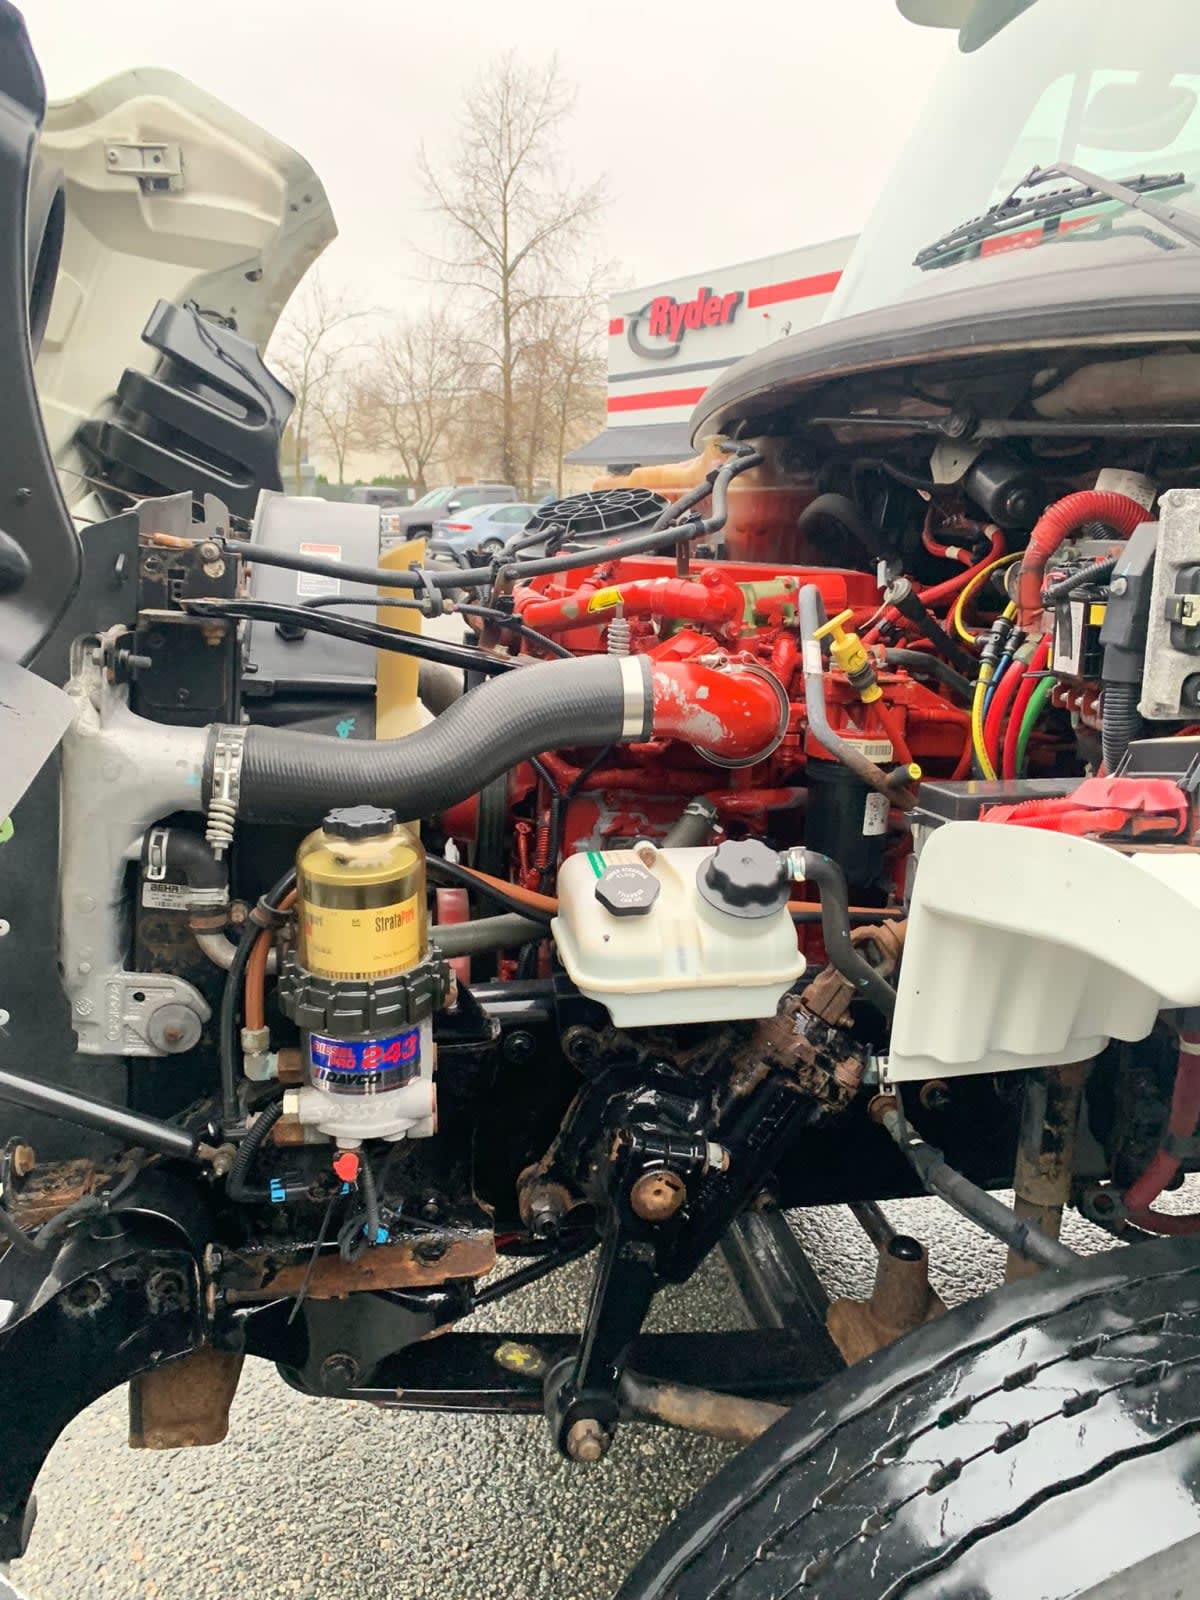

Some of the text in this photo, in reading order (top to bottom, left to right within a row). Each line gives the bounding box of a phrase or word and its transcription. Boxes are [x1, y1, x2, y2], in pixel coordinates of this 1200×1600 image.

[649, 287, 743, 342] Ryder
[361, 1034, 417, 1070] 243
[326, 1071, 382, 1086] DAVCO
